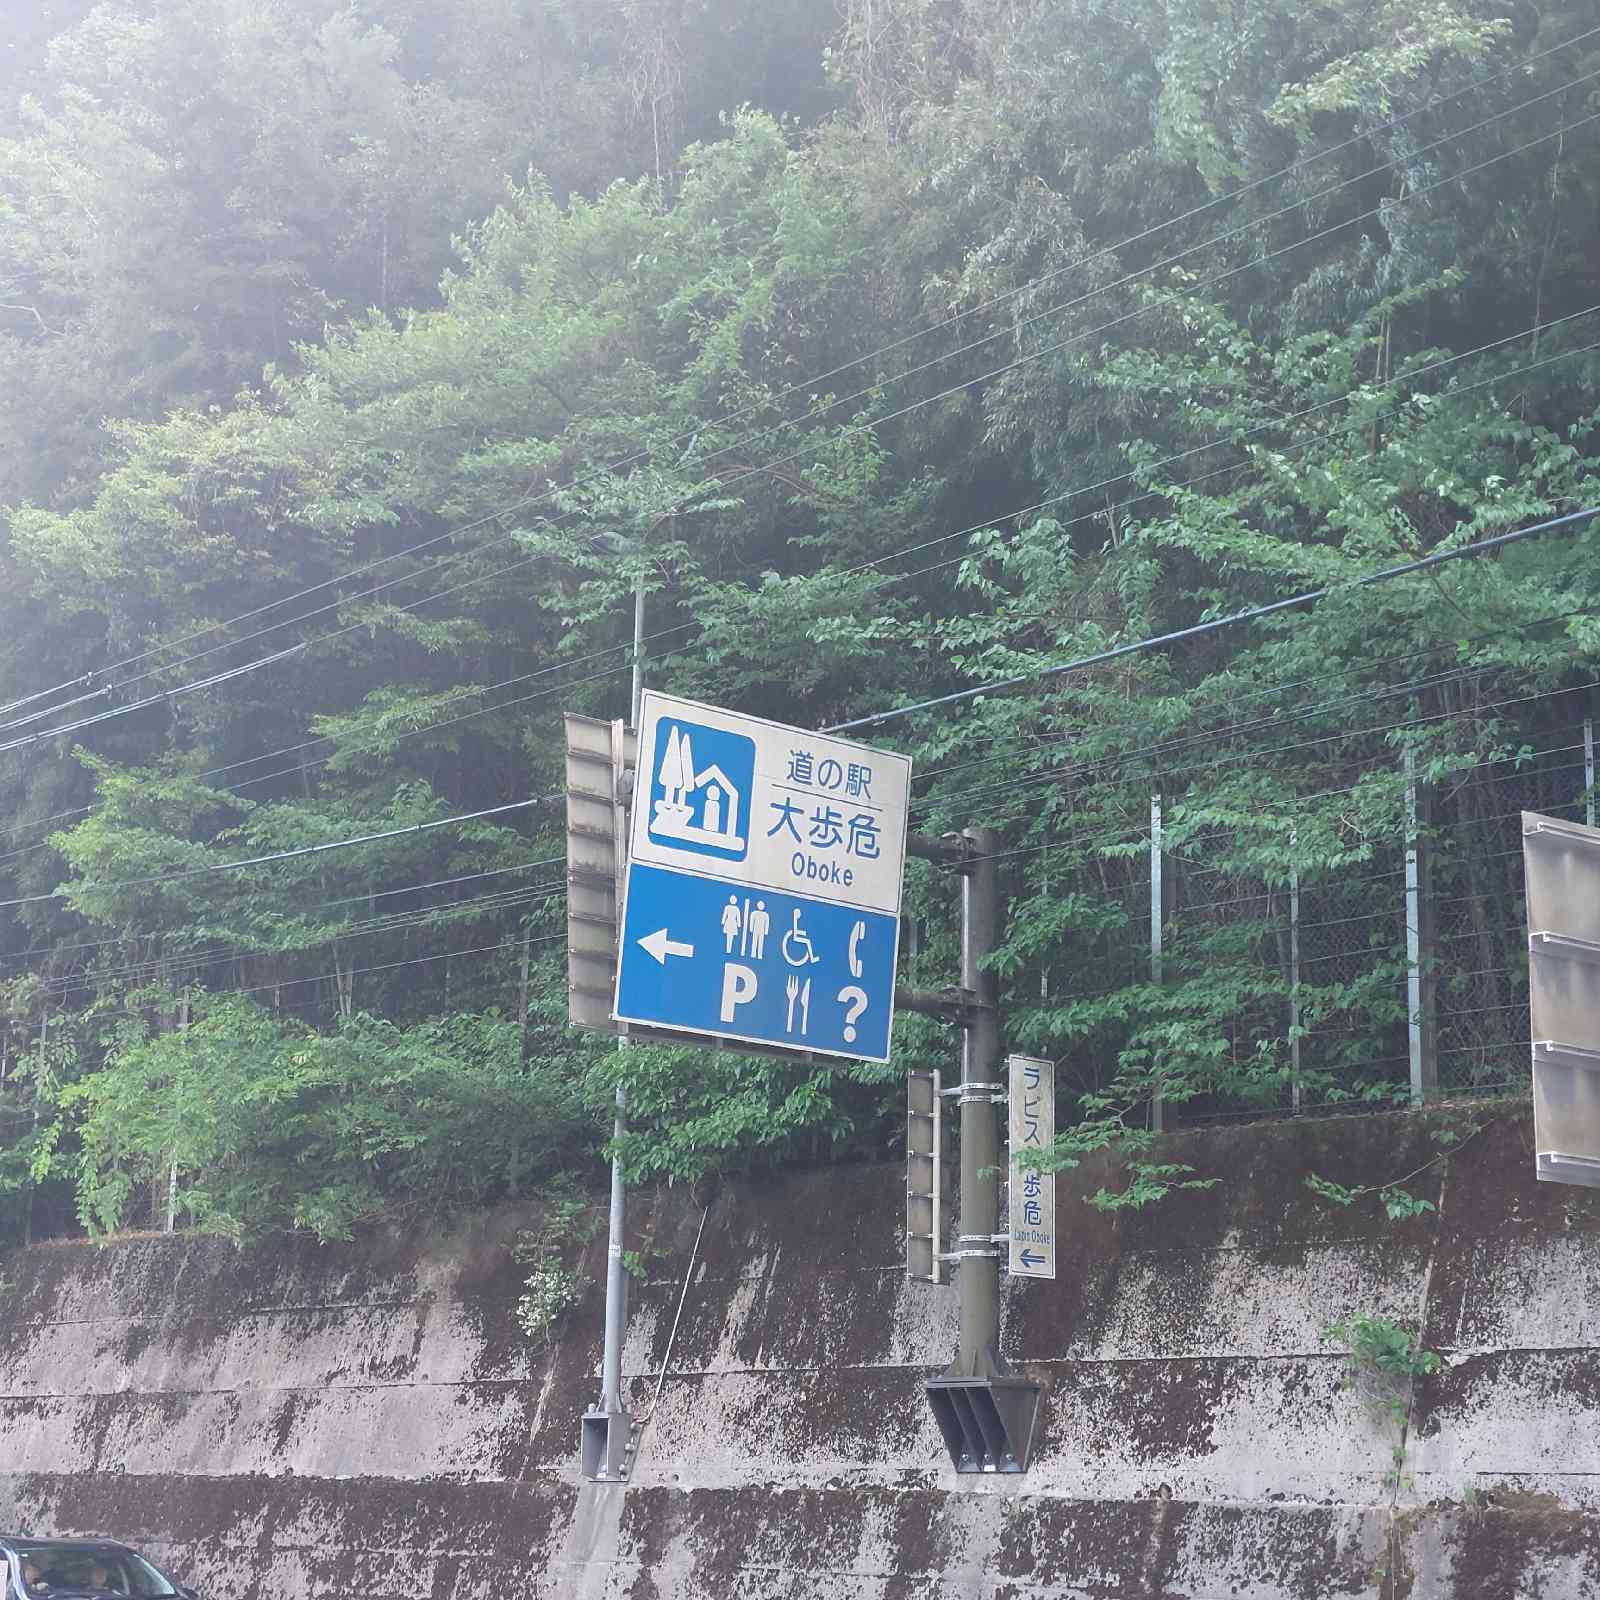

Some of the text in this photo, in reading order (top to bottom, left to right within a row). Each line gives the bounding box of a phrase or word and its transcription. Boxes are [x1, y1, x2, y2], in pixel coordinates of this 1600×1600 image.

[787, 750, 872, 799] 道の駅
[767, 797, 881, 860] 大歩危
[791, 852, 854, 887] Oboke
[1023, 1067, 1042, 1226] ラピス歩危
